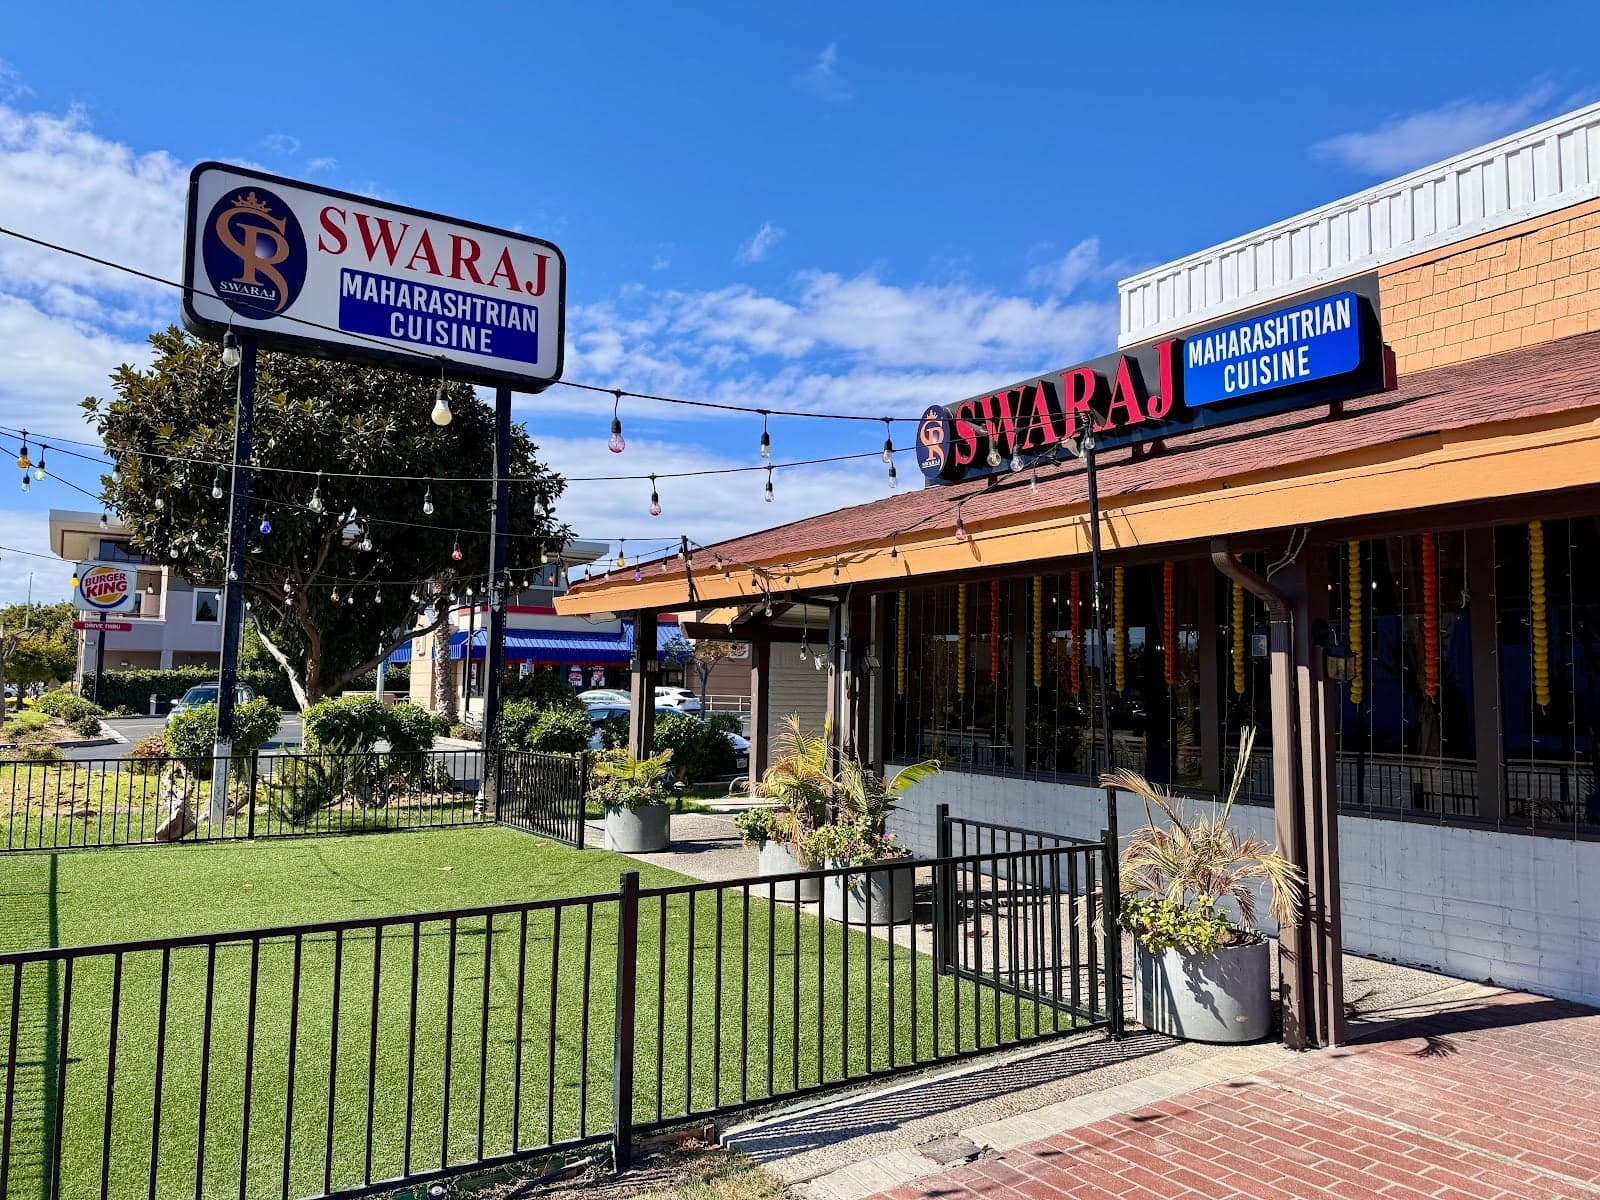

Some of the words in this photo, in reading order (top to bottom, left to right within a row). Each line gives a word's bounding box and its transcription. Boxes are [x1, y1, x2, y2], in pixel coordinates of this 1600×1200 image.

[318, 206, 551, 297] SWARAJ
[219, 281, 276, 298] SWARAJ
[342, 271, 537, 333] MAHARASHTRIAN
[390, 312, 494, 354] CUISINE
[1188, 297, 1352, 369] MAHARASHTRIAN
[1224, 346, 1311, 393] CUISINE
[954, 338, 1180, 466] SWARAJ
[85, 573, 126, 587] BURGER
[86, 581, 128, 598] KING
